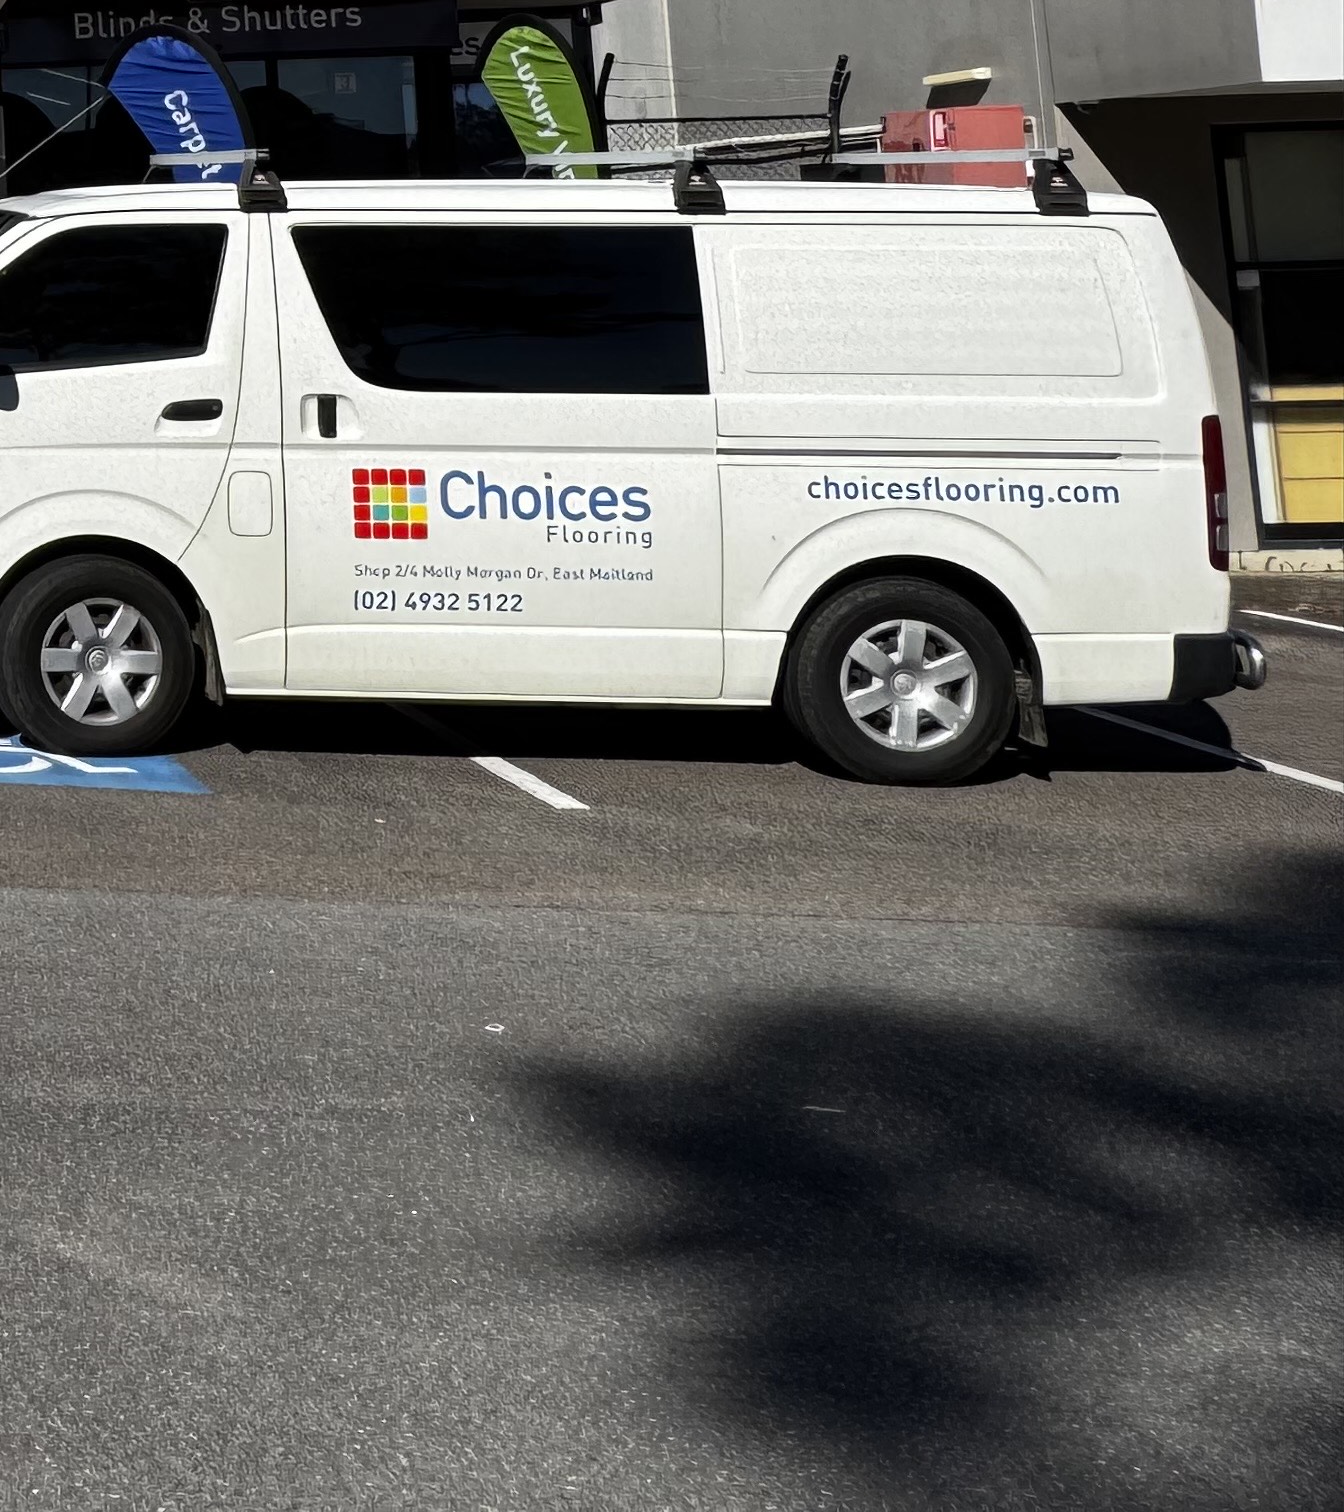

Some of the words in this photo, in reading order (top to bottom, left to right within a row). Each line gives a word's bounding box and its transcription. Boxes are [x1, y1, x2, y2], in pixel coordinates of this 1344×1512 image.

[187, 7, 211, 34] &
[221, 4, 363, 32] Shutters
[510, 45, 561, 138] Luxury
[164, 90, 223, 180] Carpt
[440, 470, 652, 522] Choices
[807, 475, 1120, 509] choicesflooring.com
[546, 525, 653, 549] Flooring
[354, 564, 391, 580] Shop
[422, 565, 462, 580] Molly
[466, 567, 523, 581] Morgan
[553, 567, 585, 581] East
[589, 567, 654, 581] Maitland
[353, 589, 396, 612] (02)
[404, 592, 460, 611] 4932
[467, 592, 524, 612] 5122
